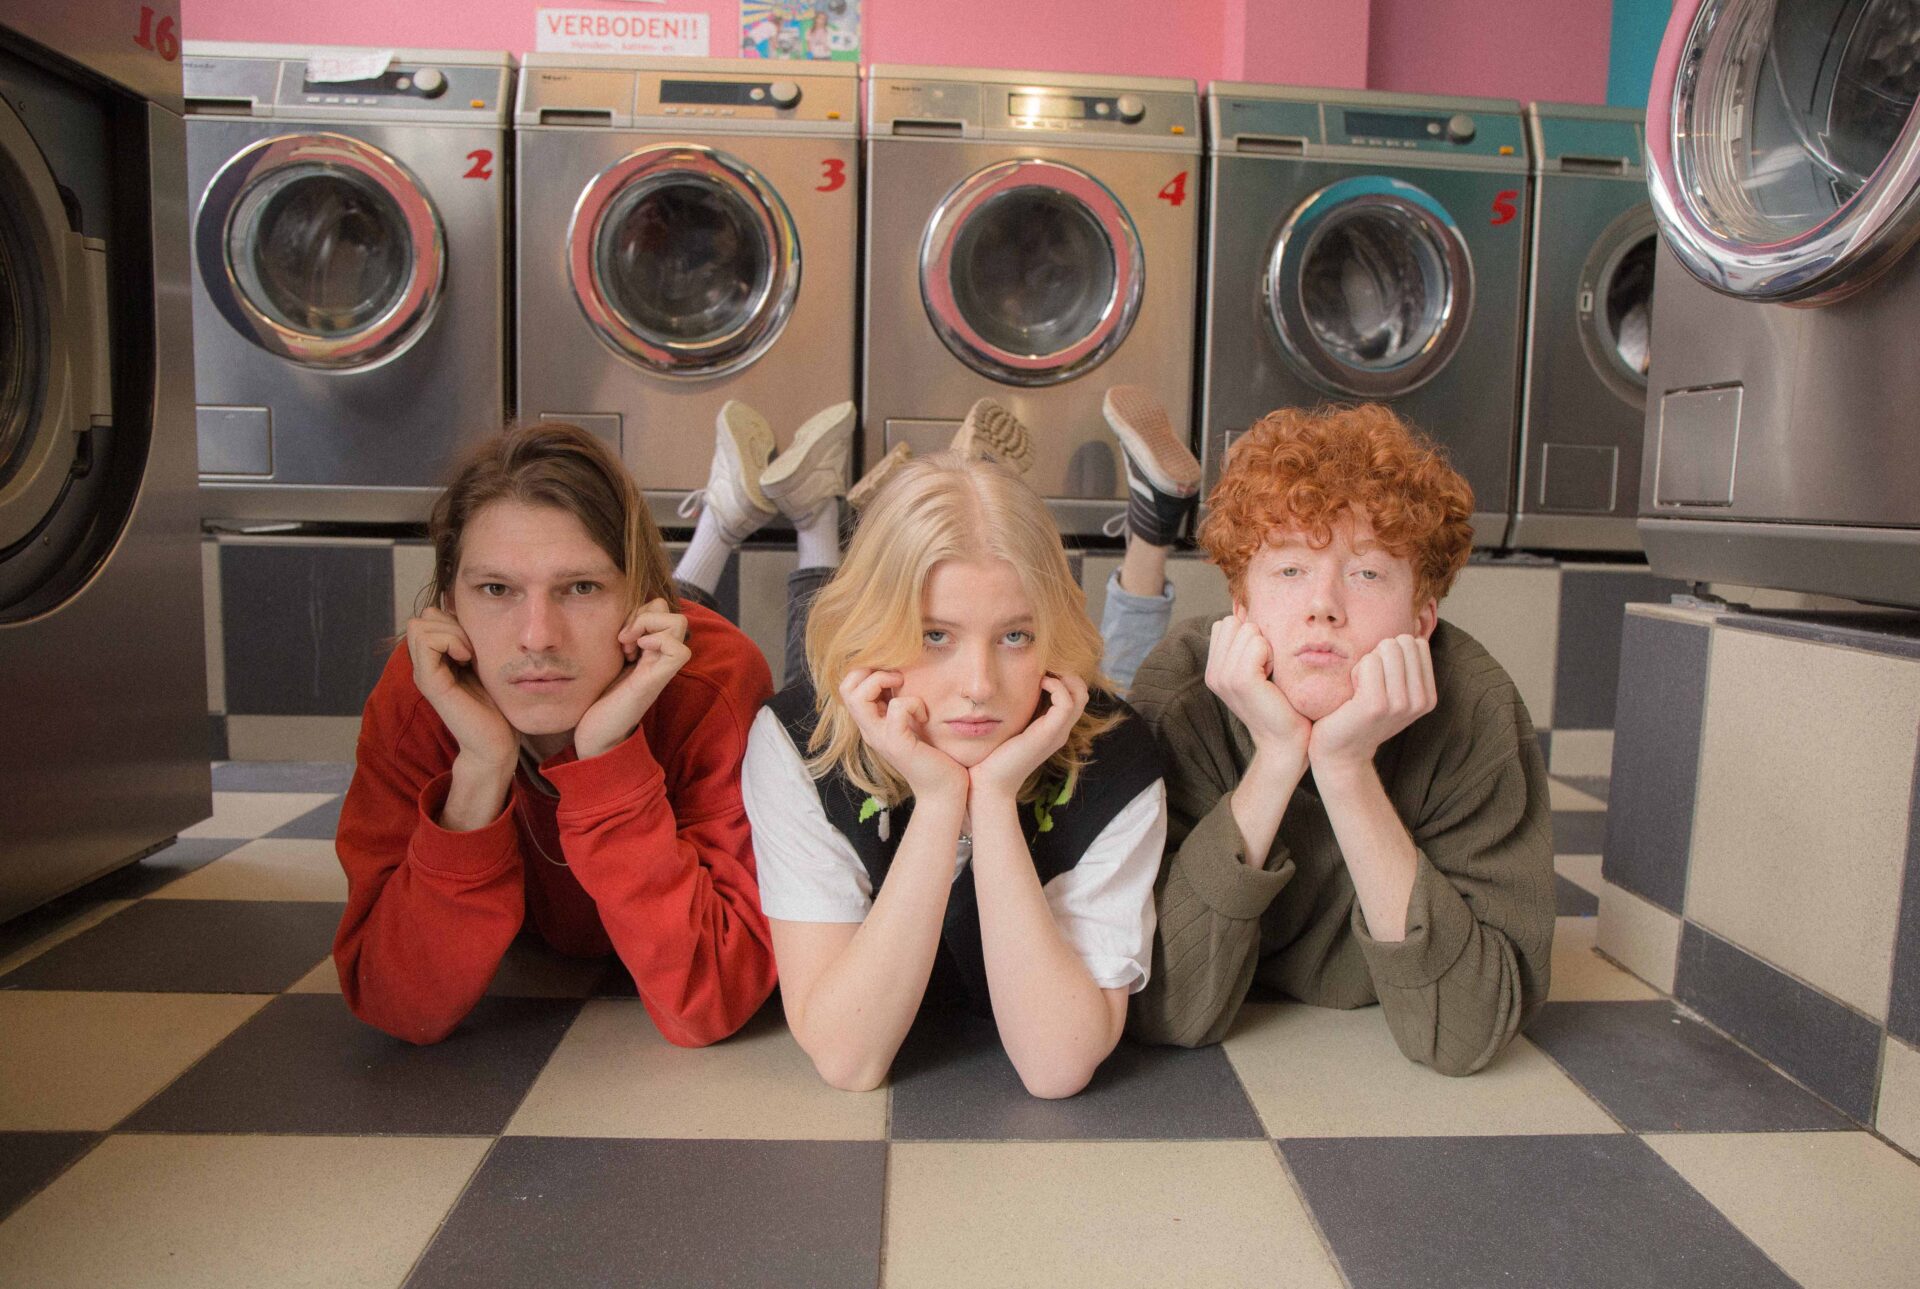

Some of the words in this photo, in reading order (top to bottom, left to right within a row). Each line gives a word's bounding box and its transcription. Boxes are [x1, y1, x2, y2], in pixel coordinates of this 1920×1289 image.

[547, 15, 698, 40] VERBODEN!!
[464, 149, 493, 180] 2
[816, 158, 847, 192] 3
[1158, 170, 1188, 206] 4
[1491, 191, 1519, 228] 5
